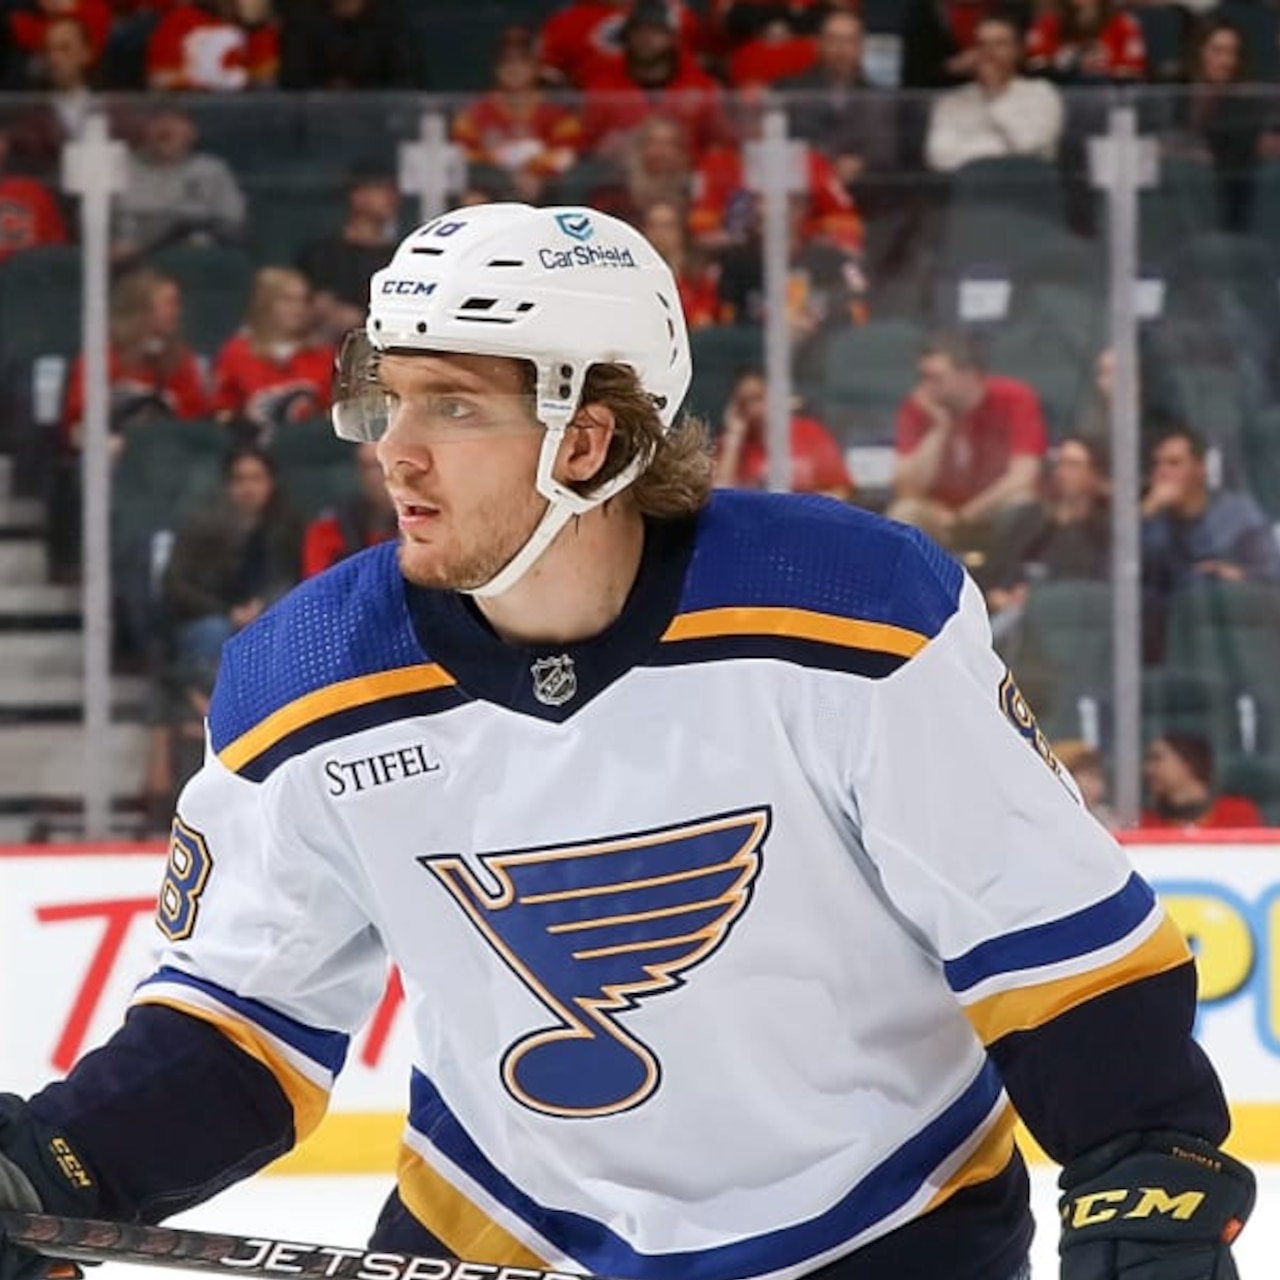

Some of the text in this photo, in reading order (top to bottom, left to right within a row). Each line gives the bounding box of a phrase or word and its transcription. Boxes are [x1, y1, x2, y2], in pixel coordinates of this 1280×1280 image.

[538, 244, 639, 271] CarShield
[380, 280, 439, 297] CCM
[324, 744, 441, 797] STIFEL
[50, 1136, 92, 1188] CCM
[1062, 1187, 1206, 1229] CM
